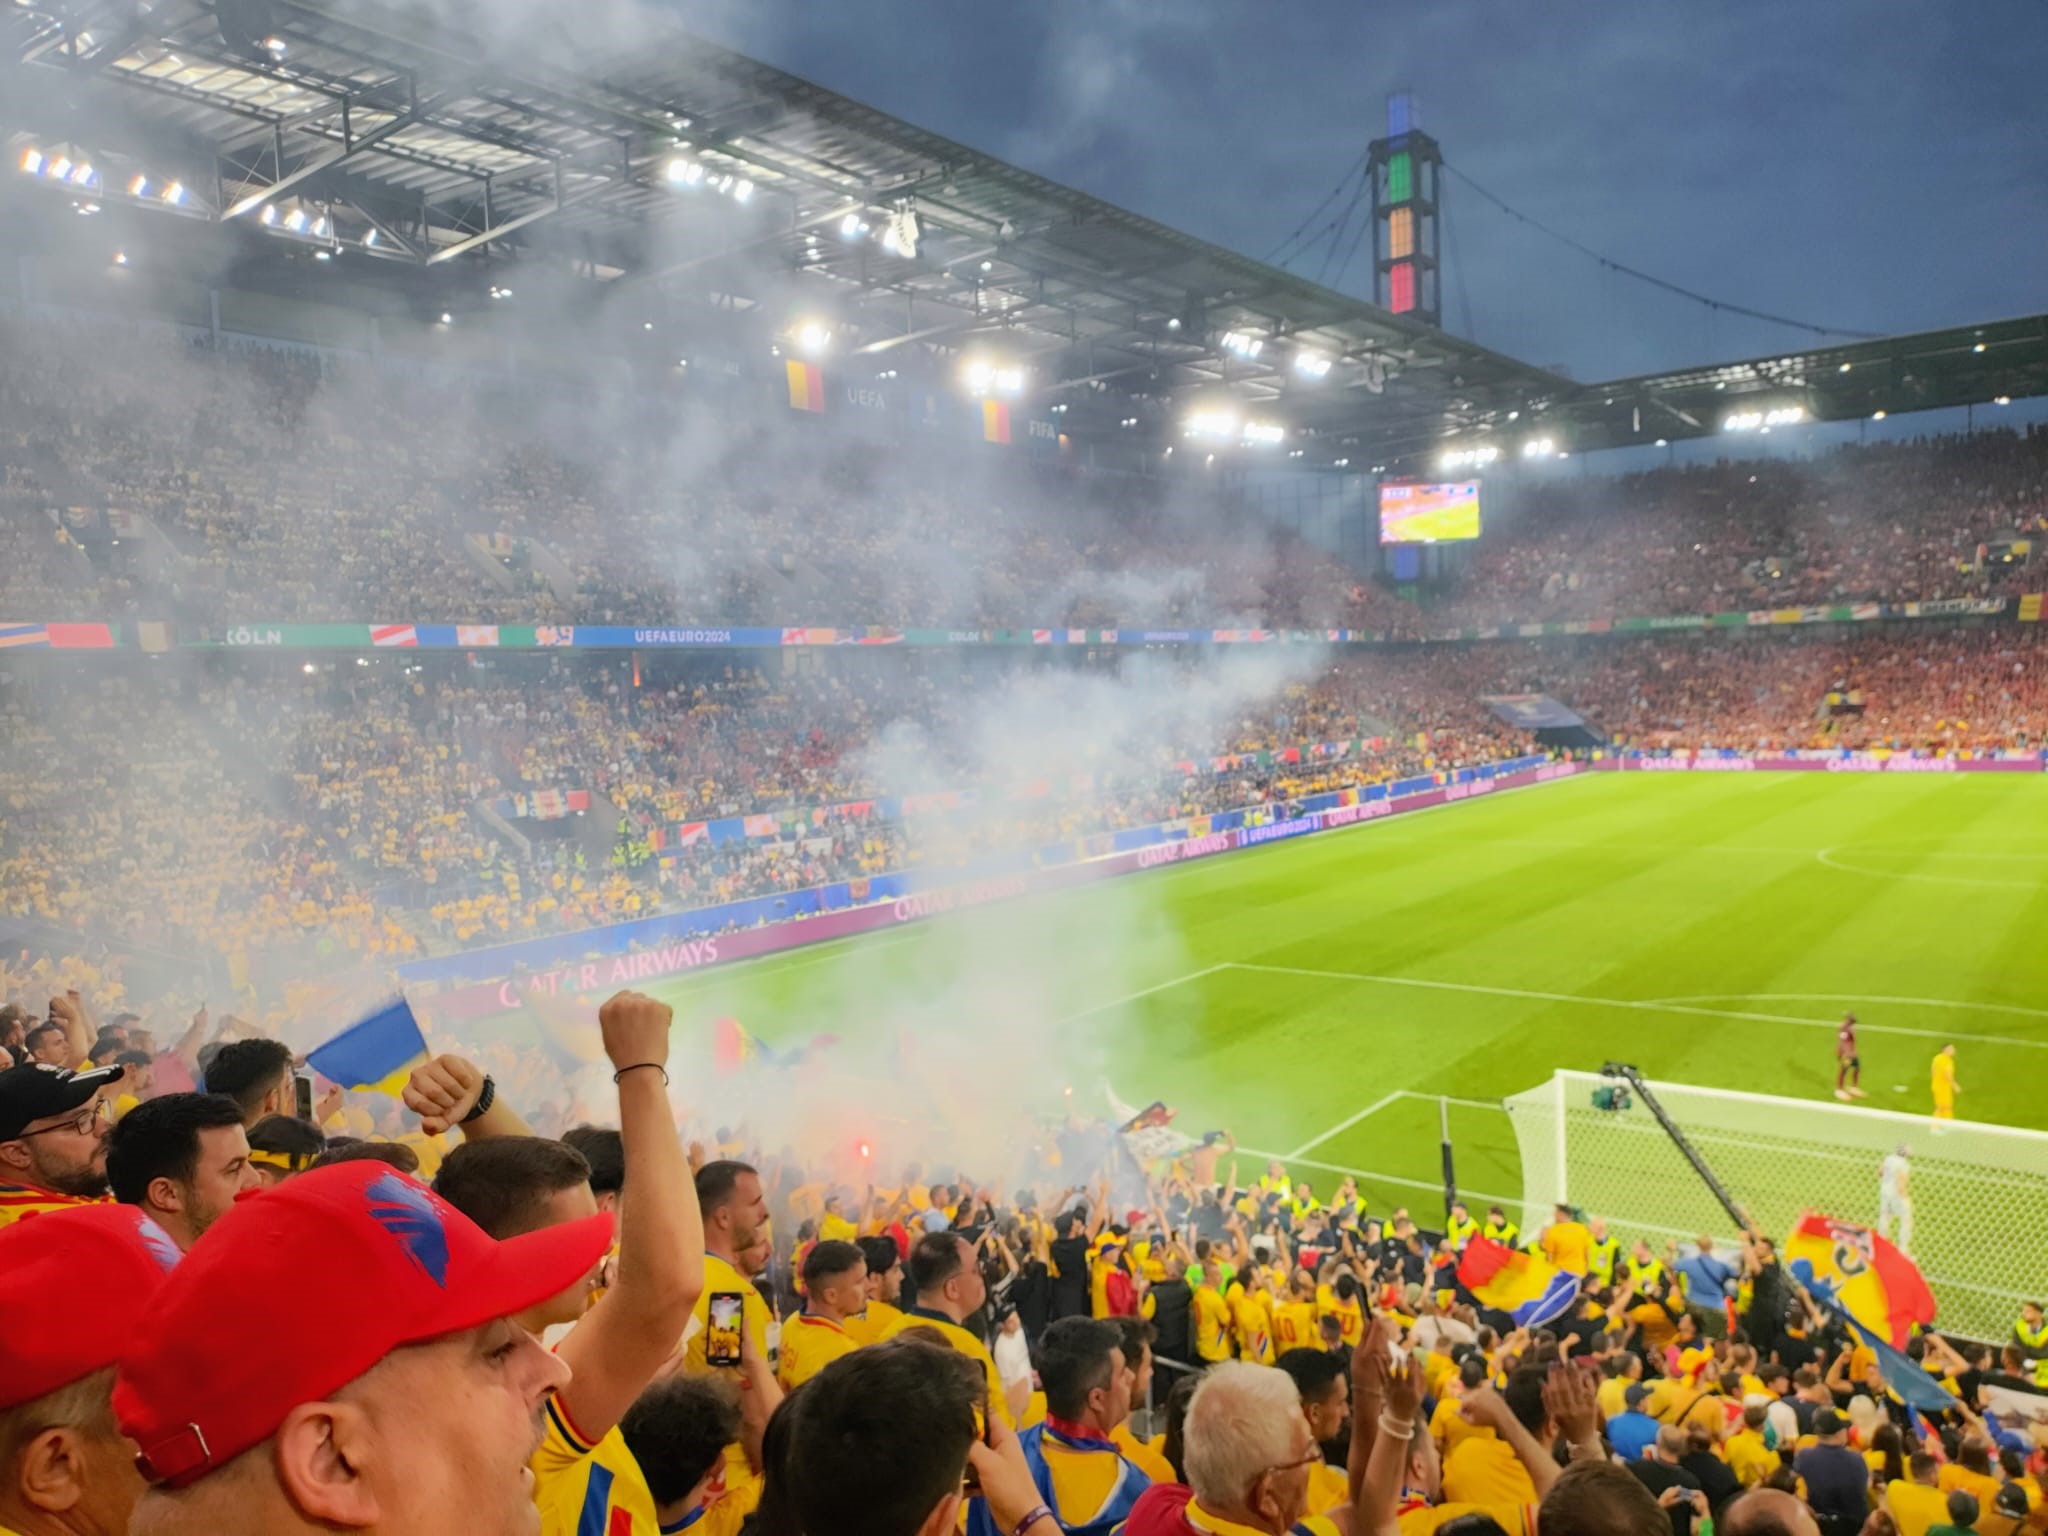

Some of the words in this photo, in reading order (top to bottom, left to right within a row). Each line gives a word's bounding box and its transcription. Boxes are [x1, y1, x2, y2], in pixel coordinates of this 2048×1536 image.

[847, 387, 886, 409] UEFA
[1029, 420, 1056, 440] FIFA
[610, 937, 719, 984] AIRWAYS
